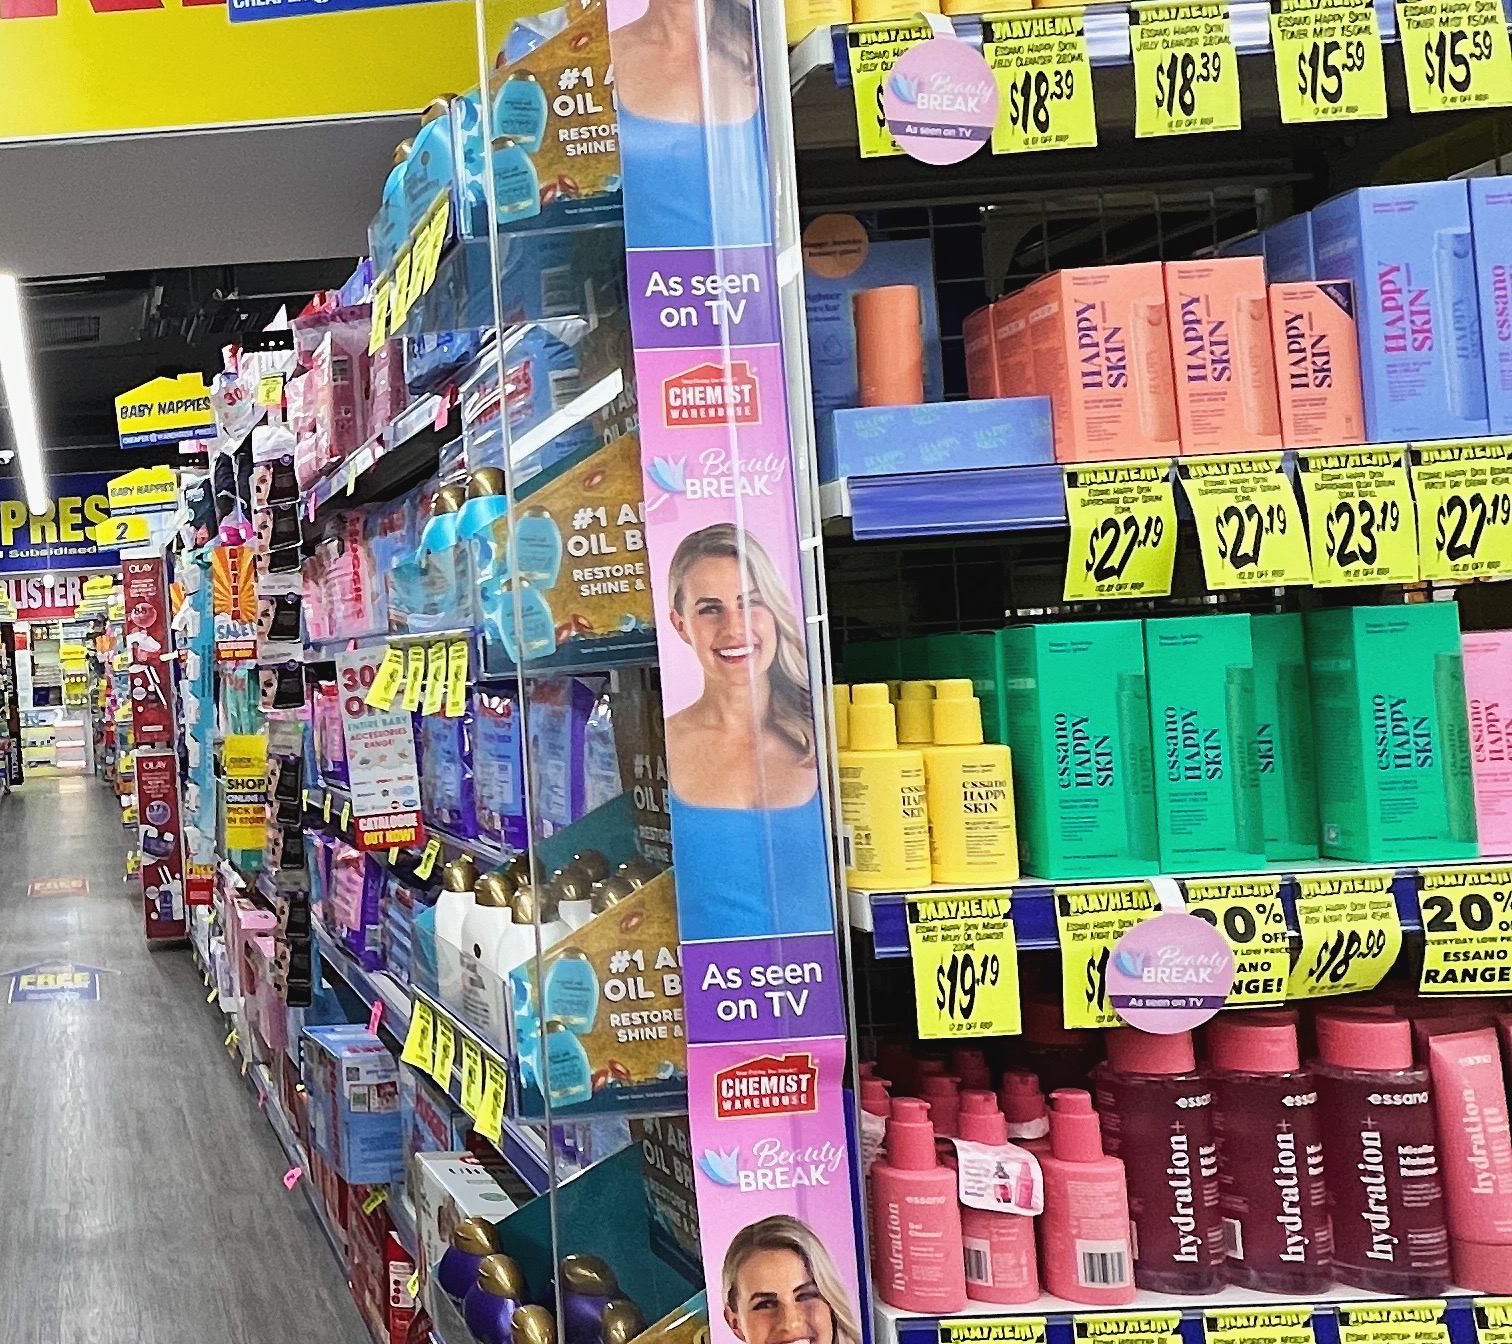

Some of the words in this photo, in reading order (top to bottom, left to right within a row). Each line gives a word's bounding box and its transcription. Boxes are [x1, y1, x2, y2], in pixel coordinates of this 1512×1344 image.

[1080, 300, 1102, 389] HAPPY
[1108, 326, 1129, 388] SKIN
[121, 404, 154, 419] BABY
[158, 397, 210, 415] NAPPIES
[685, 474, 773, 500] BREAK
[116, 523, 129, 540] 2
[1058, 712, 1070, 788] essano
[1074, 714, 1093, 787] HAPPY
[1095, 735, 1114, 788] SKIN
[227, 778, 265, 791] SHOP
[610, 952, 647, 972] #1
[1444, 949, 1507, 961] ESSANO
[604, 975, 652, 1002] OIL
[702, 963, 742, 990] As
[750, 962, 822, 986] seen
[610, 1009, 682, 1026] RESTORE
[717, 999, 758, 1021] on
[765, 989, 809, 1017] TV
[617, 1026, 670, 1042] SHINE
[721, 1073, 811, 1099] CHEMIST
[1367, 1090, 1428, 1106] essano
[721, 1094, 808, 1111] WAREHOUSE
